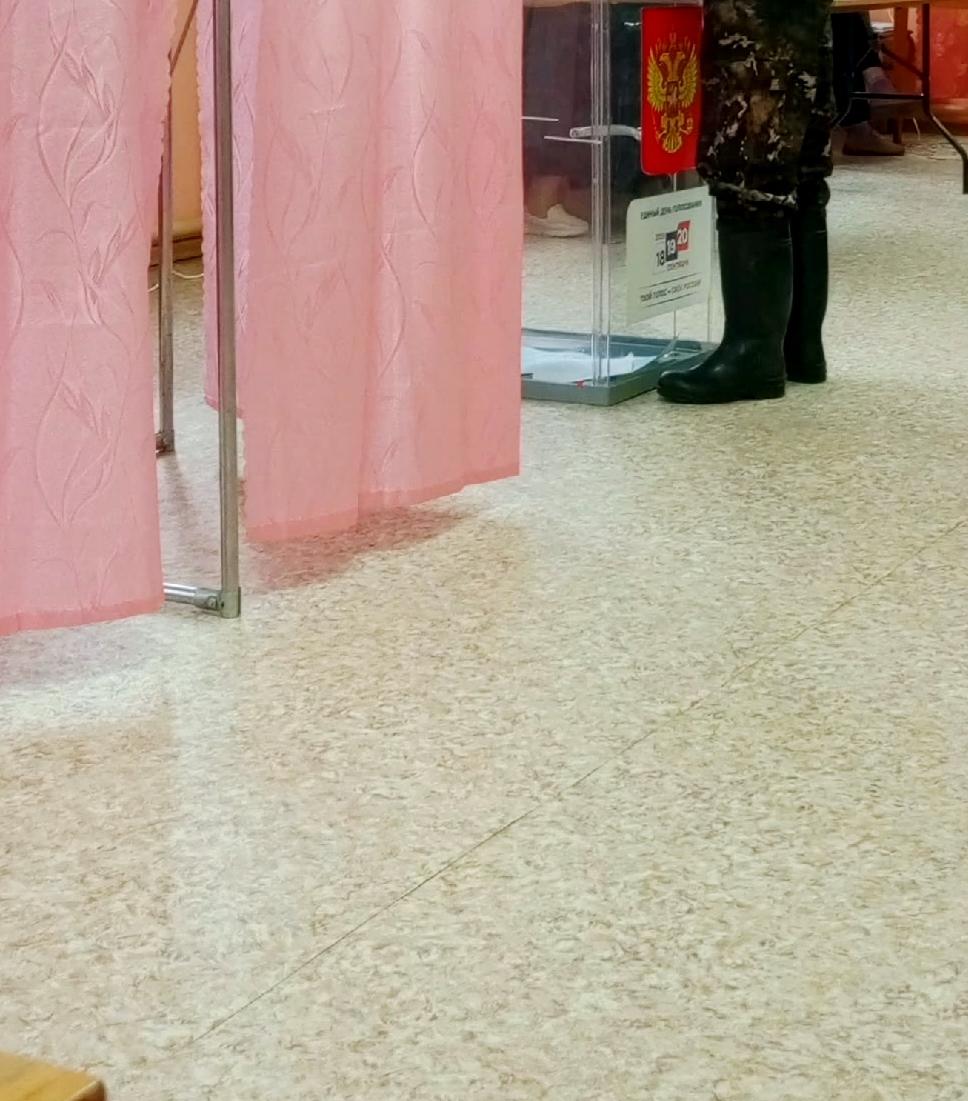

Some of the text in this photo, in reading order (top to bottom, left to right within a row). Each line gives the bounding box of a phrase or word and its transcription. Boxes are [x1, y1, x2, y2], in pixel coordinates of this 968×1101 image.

[656, 250, 665, 268] 18
[666, 238, 676, 256] 19
[676, 227, 687, 245] 20
